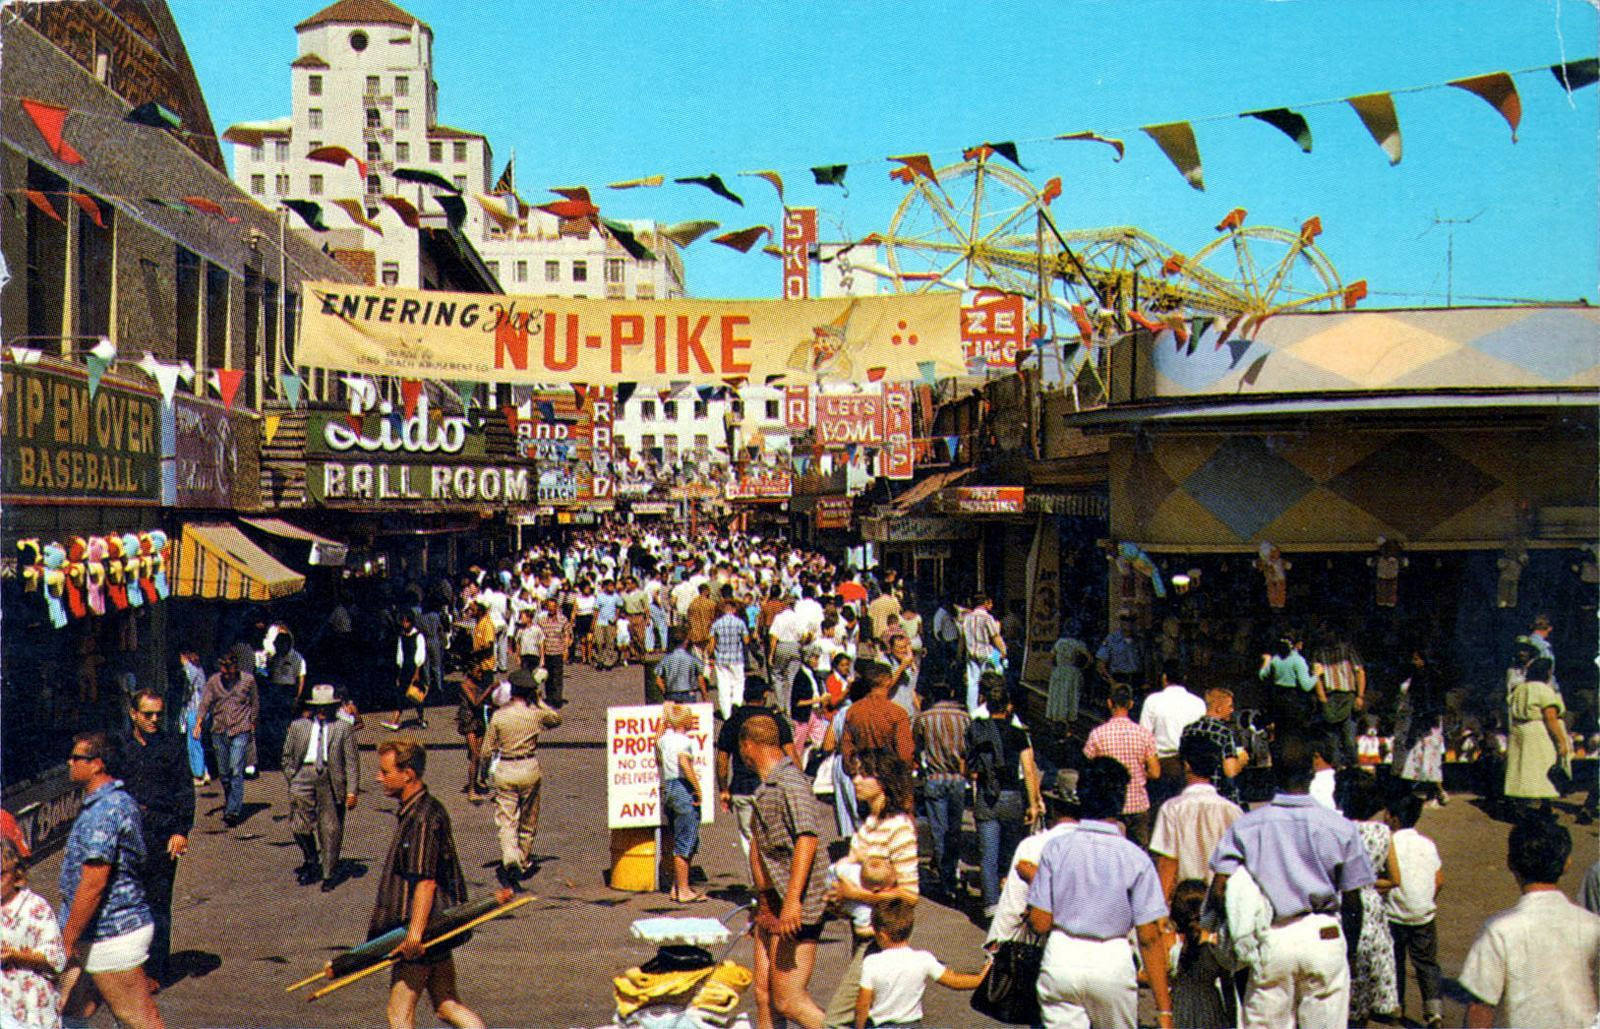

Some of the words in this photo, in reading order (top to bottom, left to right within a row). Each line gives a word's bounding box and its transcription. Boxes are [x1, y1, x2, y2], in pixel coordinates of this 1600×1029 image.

[321, 293, 479, 328] ENTERING
[494, 310, 752, 374] NU-PIKE
[96, 392, 154, 453] OVER
[324, 377, 471, 452] Lido
[20, 447, 138, 492] BASEBALL
[324, 463, 421, 498] BALL
[431, 464, 528, 500] ROOM
[614, 713, 700, 735] PRIVE
[618, 758, 636, 769] NO
[620, 802, 656, 818] ANY
